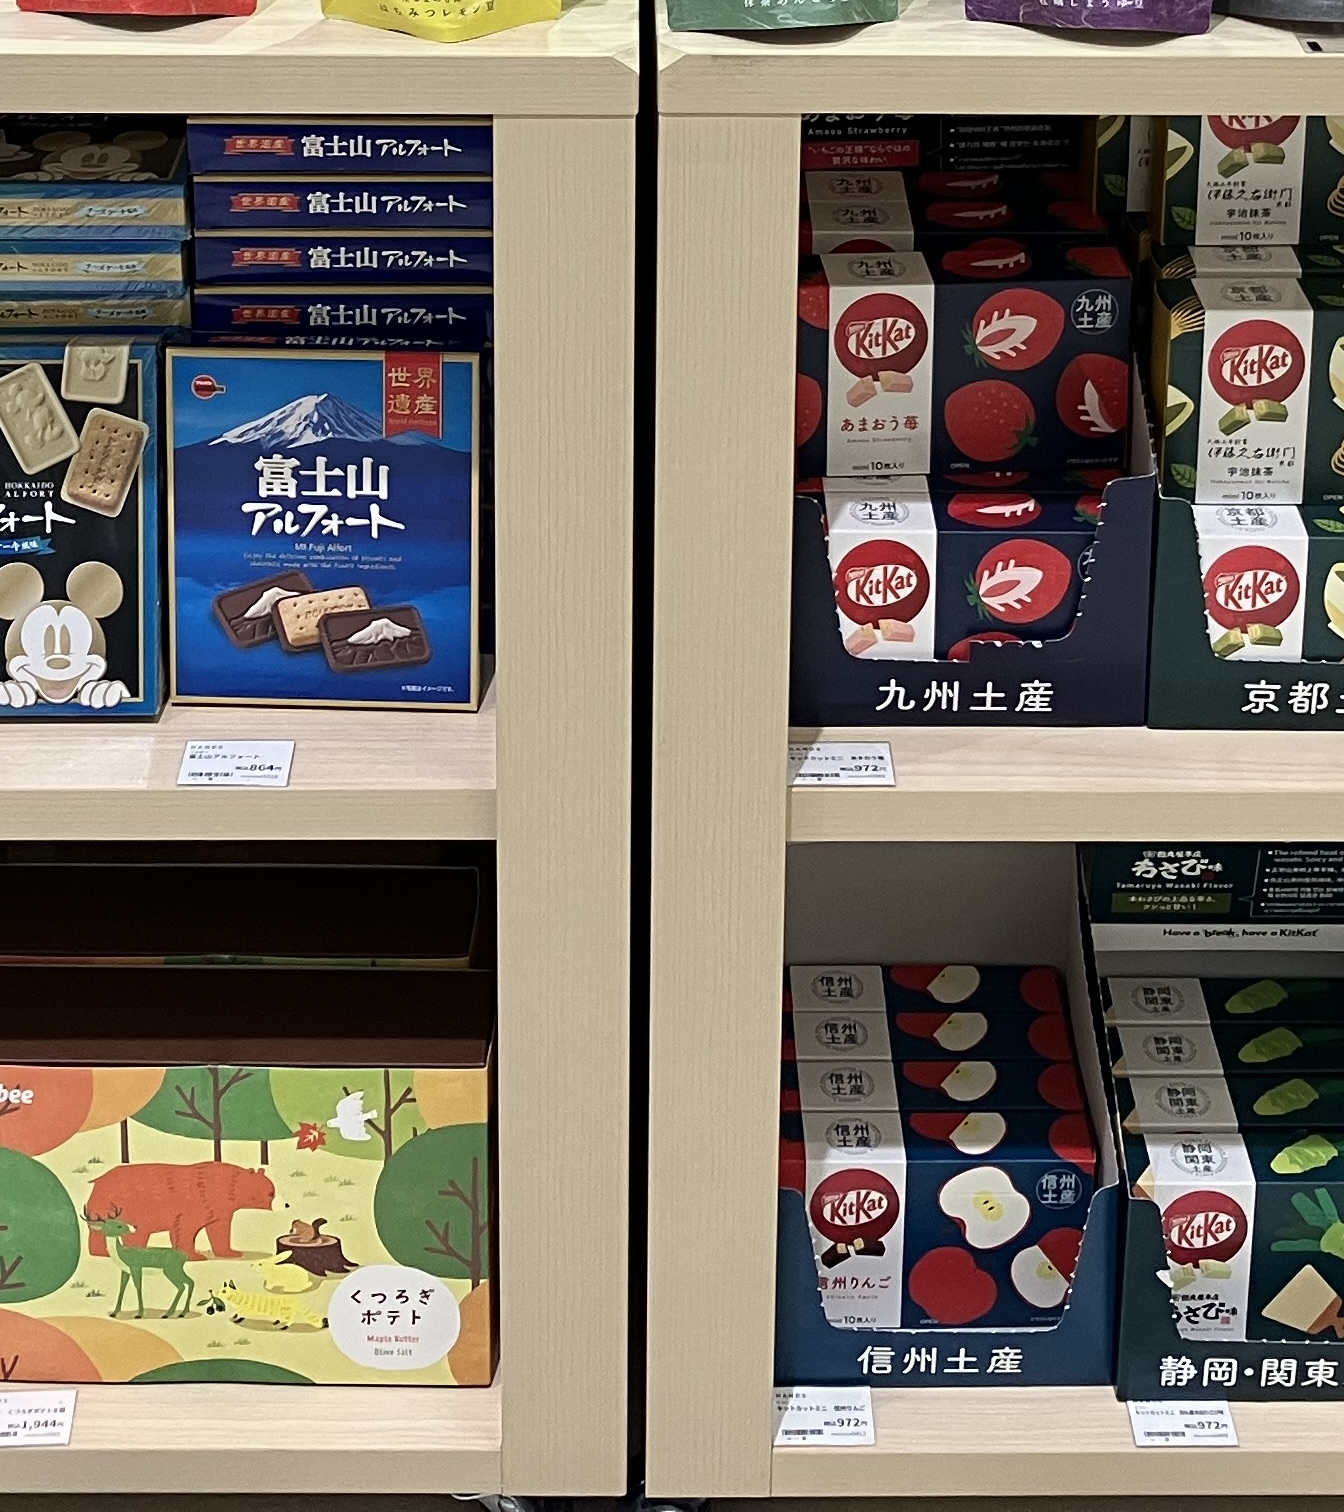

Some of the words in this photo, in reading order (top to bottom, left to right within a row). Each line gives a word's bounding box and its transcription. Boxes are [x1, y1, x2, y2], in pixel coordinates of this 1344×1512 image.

[300, 134, 372, 158] 富士山
[375, 138, 461, 158] アルフォート
[306, 191, 378, 215] 富士山
[379, 194, 467, 215] アルフォート
[1226, 207, 1274, 218] 宇治抹茶
[381, 250, 467, 270] アルフォート
[1075, 296, 1113, 312] 九州
[379, 307, 466, 326] アルフォート
[1075, 312, 1114, 330] 土産
[847, 316, 917, 360] KitKat
[387, 366, 438, 388] 世界
[1220, 348, 1293, 388] KitKat
[388, 394, 437, 415] 遺産
[839, 415, 920, 434] あまおう苺
[254, 453, 390, 500] 富士山
[1226, 466, 1274, 477] 宇治抹茶
[5, 490, 54, 498] ALFORT
[240, 503, 406, 539] アルフォート
[844, 564, 918, 607] KitKat
[1214, 573, 1284, 610] KitKat
[875, 679, 1055, 713] 九州土産
[823, 1190, 888, 1226] KitKat
[1170, 1213, 1238, 1249] KitKat
[349, 1287, 434, 1306] くつろぎ
[360, 1308, 422, 1328] ポテト
[857, 1345, 1025, 1376] 信州土産
